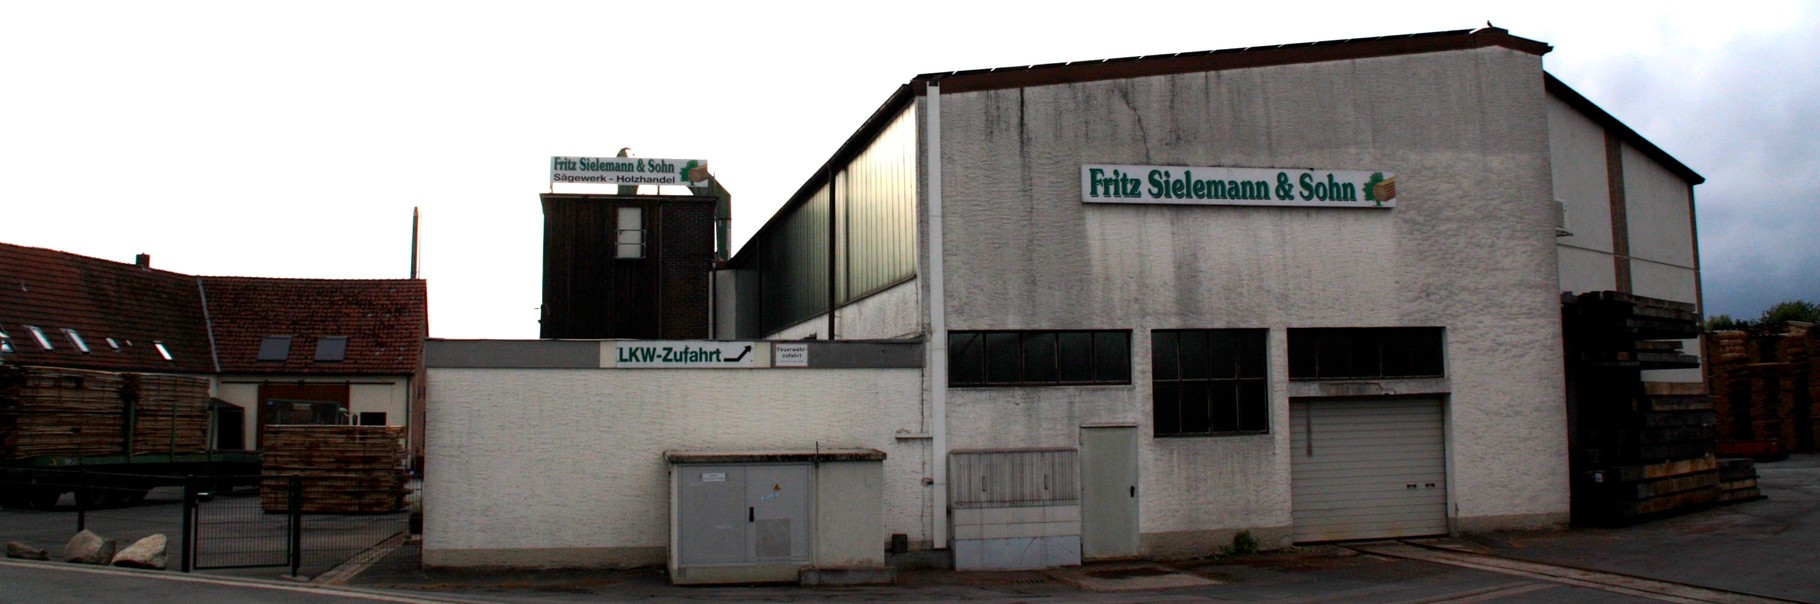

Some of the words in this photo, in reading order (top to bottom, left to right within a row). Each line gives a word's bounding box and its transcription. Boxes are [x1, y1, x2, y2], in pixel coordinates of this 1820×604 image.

[554, 157, 577, 171] Fritz
[579, 157, 634, 172] Sielemann
[636, 158, 646, 173] &
[648, 159, 675, 173] Sohn
[554, 173, 606, 183] Sägewerk
[616, 175, 676, 184] Holzhandel
[1089, 168, 1142, 198] Fritz
[1147, 169, 1271, 200] Sielemann
[1275, 172, 1295, 201] &
[1299, 173, 1357, 202] Sohn
[618, 346, 721, 363] LKW-Zufahrt
